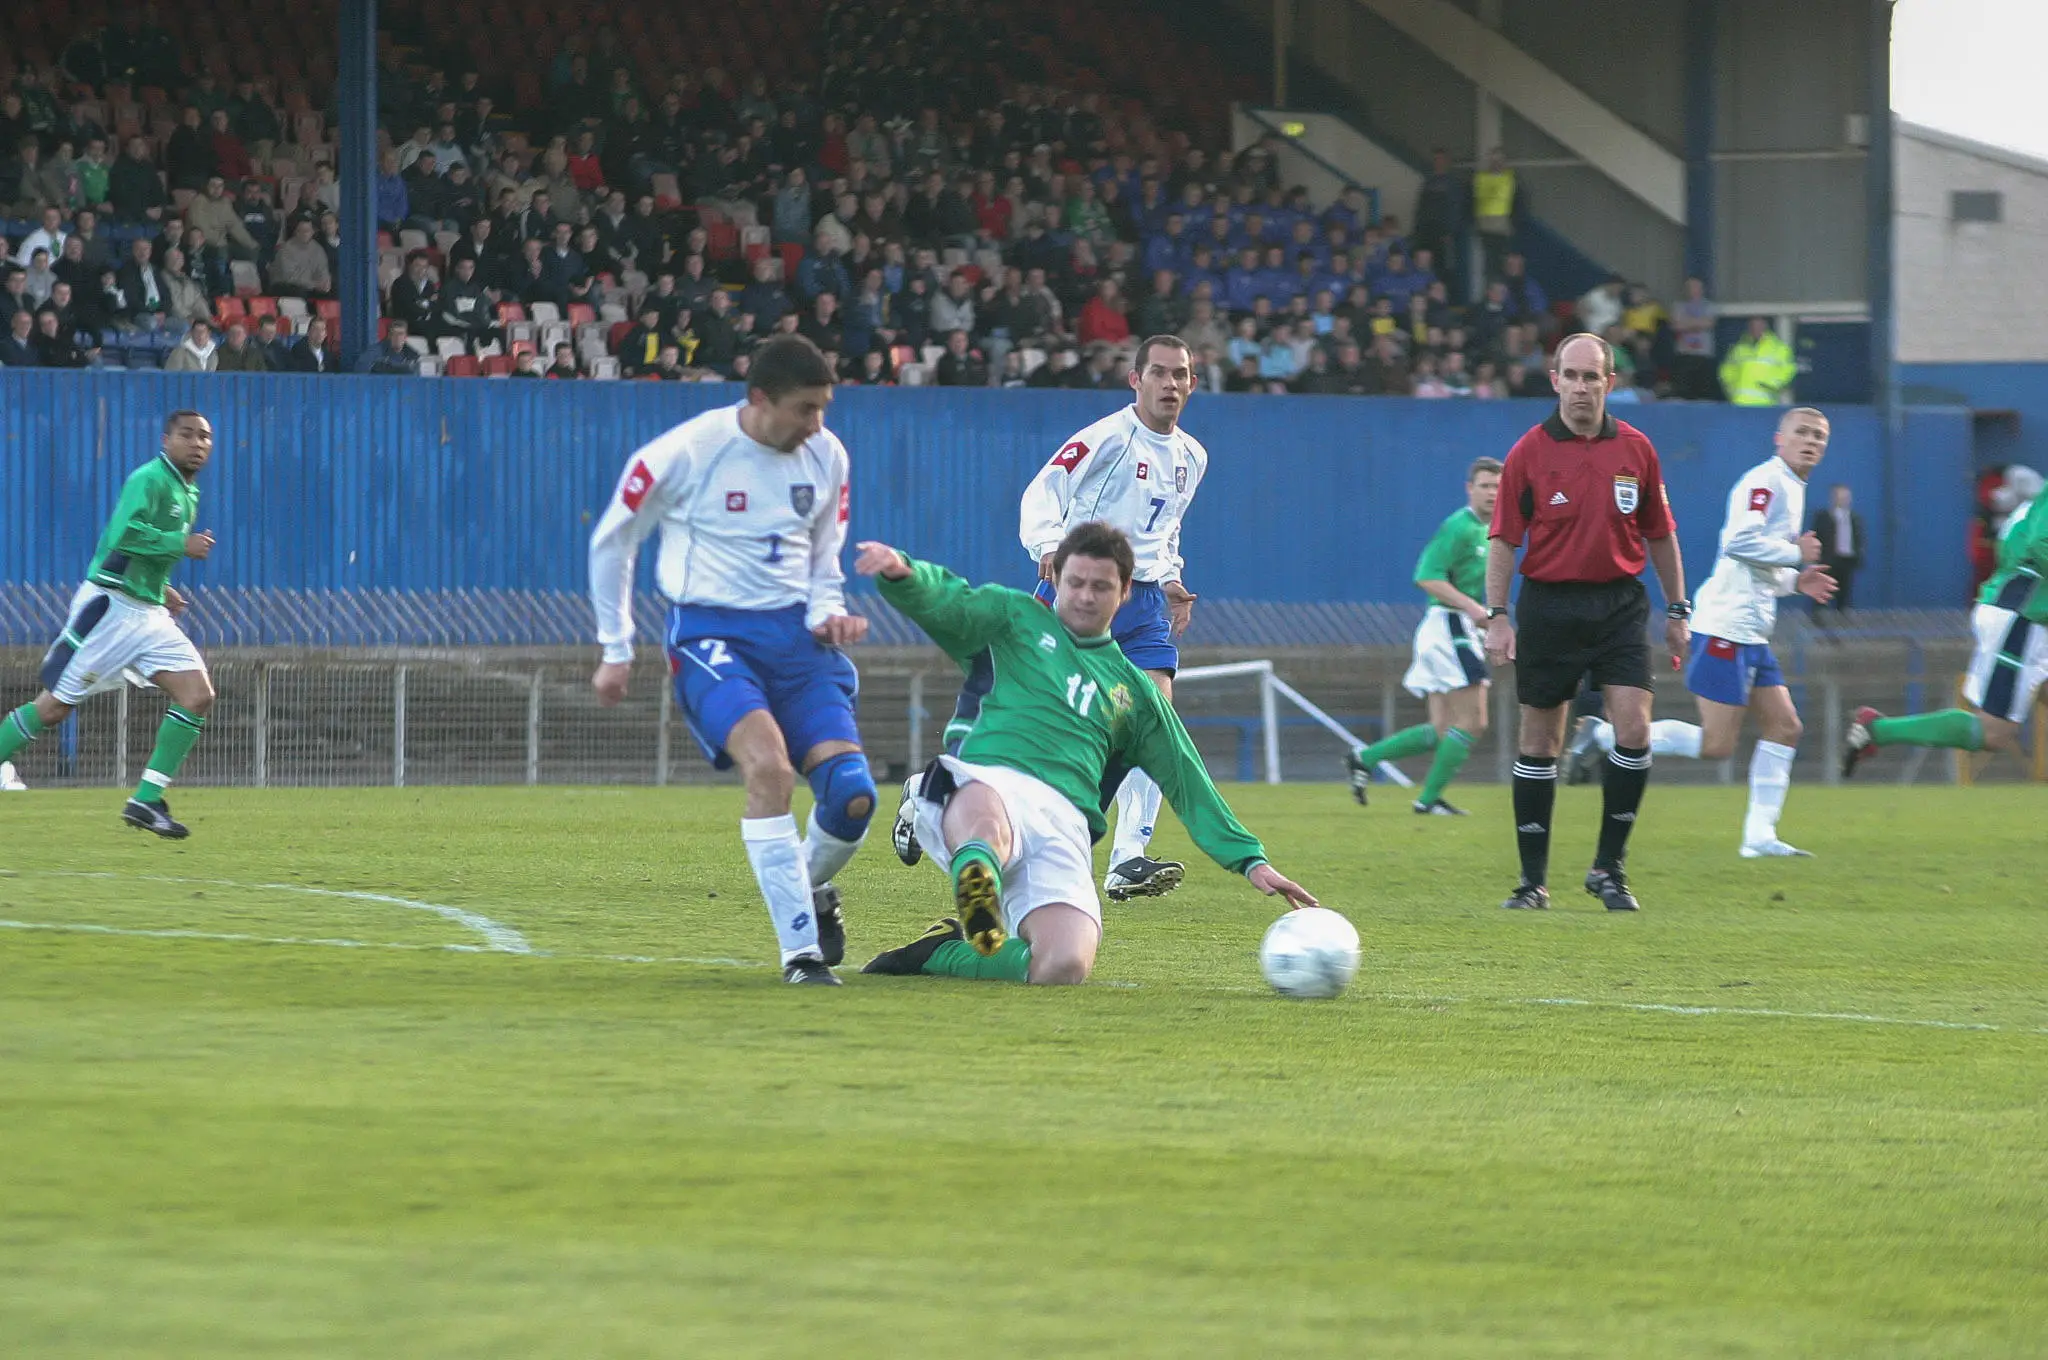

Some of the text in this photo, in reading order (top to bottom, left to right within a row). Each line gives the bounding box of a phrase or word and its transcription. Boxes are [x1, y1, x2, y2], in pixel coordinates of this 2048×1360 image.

[1145, 497, 1166, 532] 7
[699, 638, 734, 667] 2
[1066, 673, 1098, 717] 11
